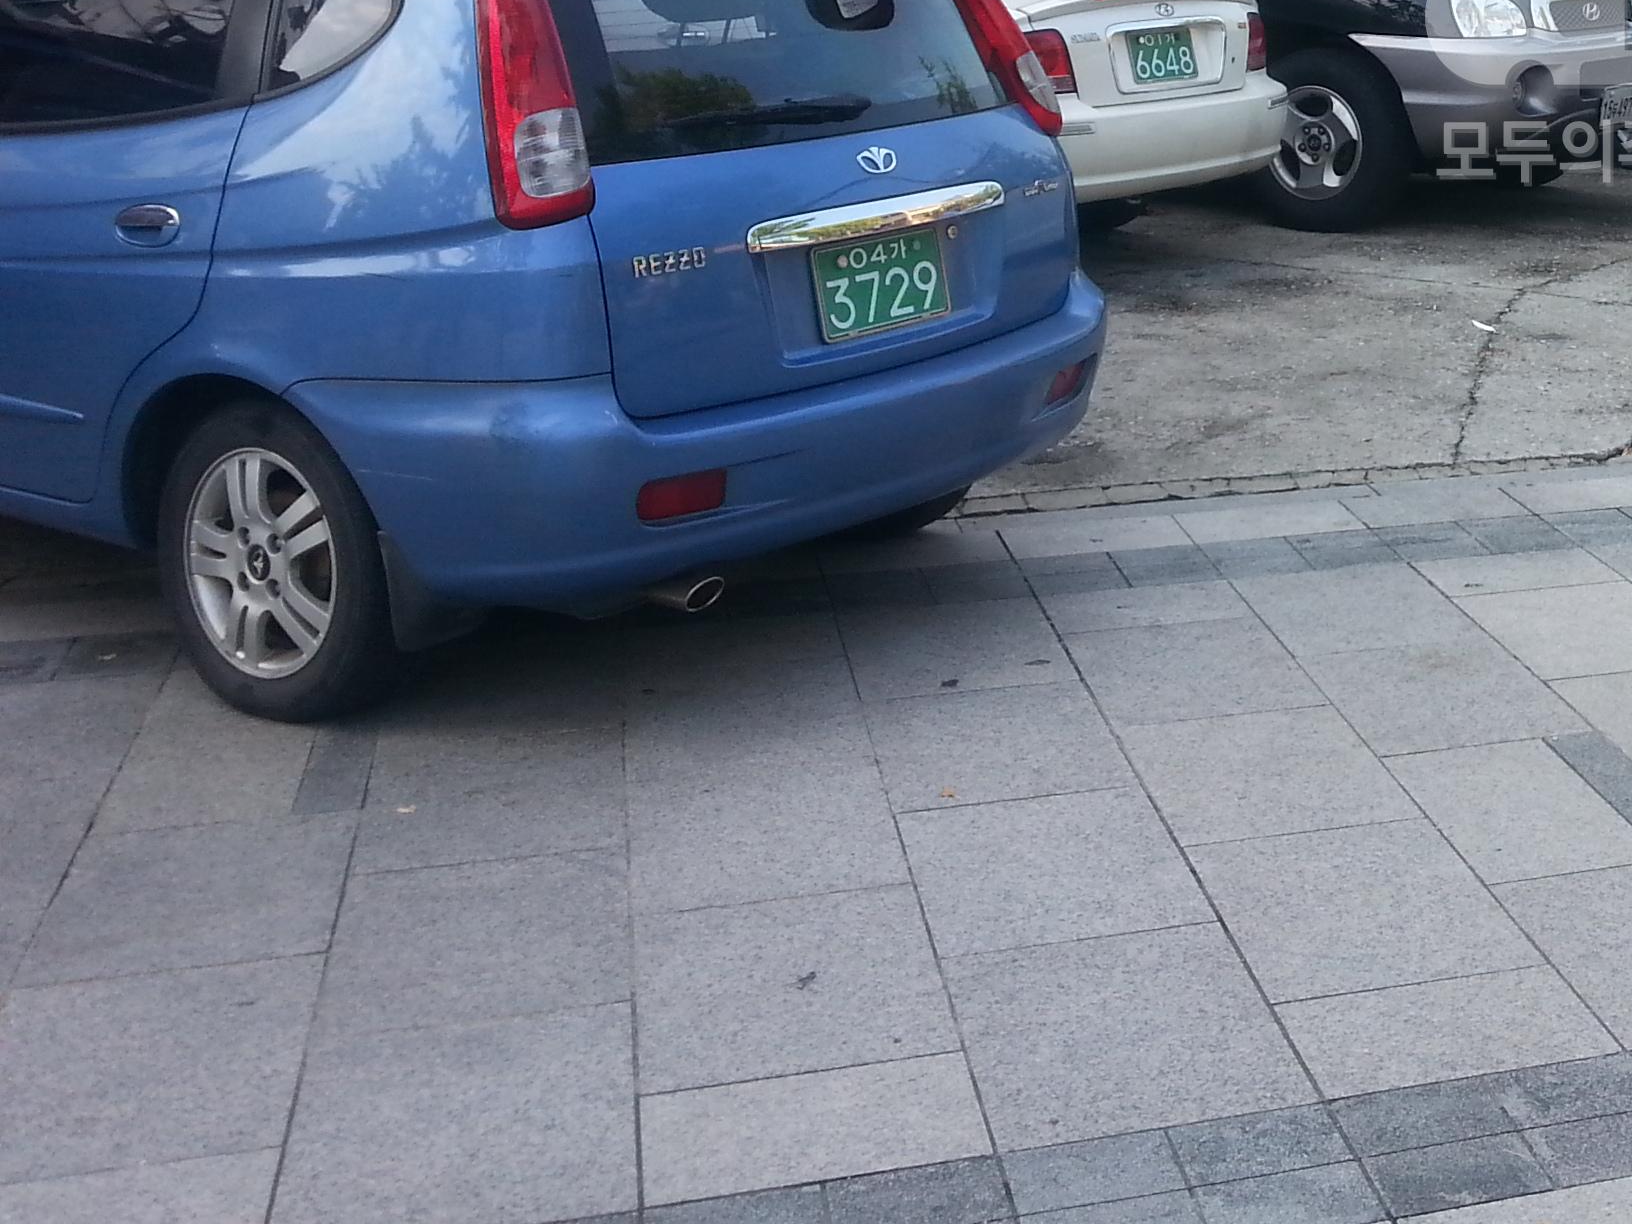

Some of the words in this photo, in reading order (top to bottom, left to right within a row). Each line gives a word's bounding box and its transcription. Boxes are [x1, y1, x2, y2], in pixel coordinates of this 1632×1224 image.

[1136, 46, 1194, 79] 6648
[632, 246, 708, 279] REZZO
[848, 240, 908, 268] 04가
[825, 260, 938, 330] 3729
